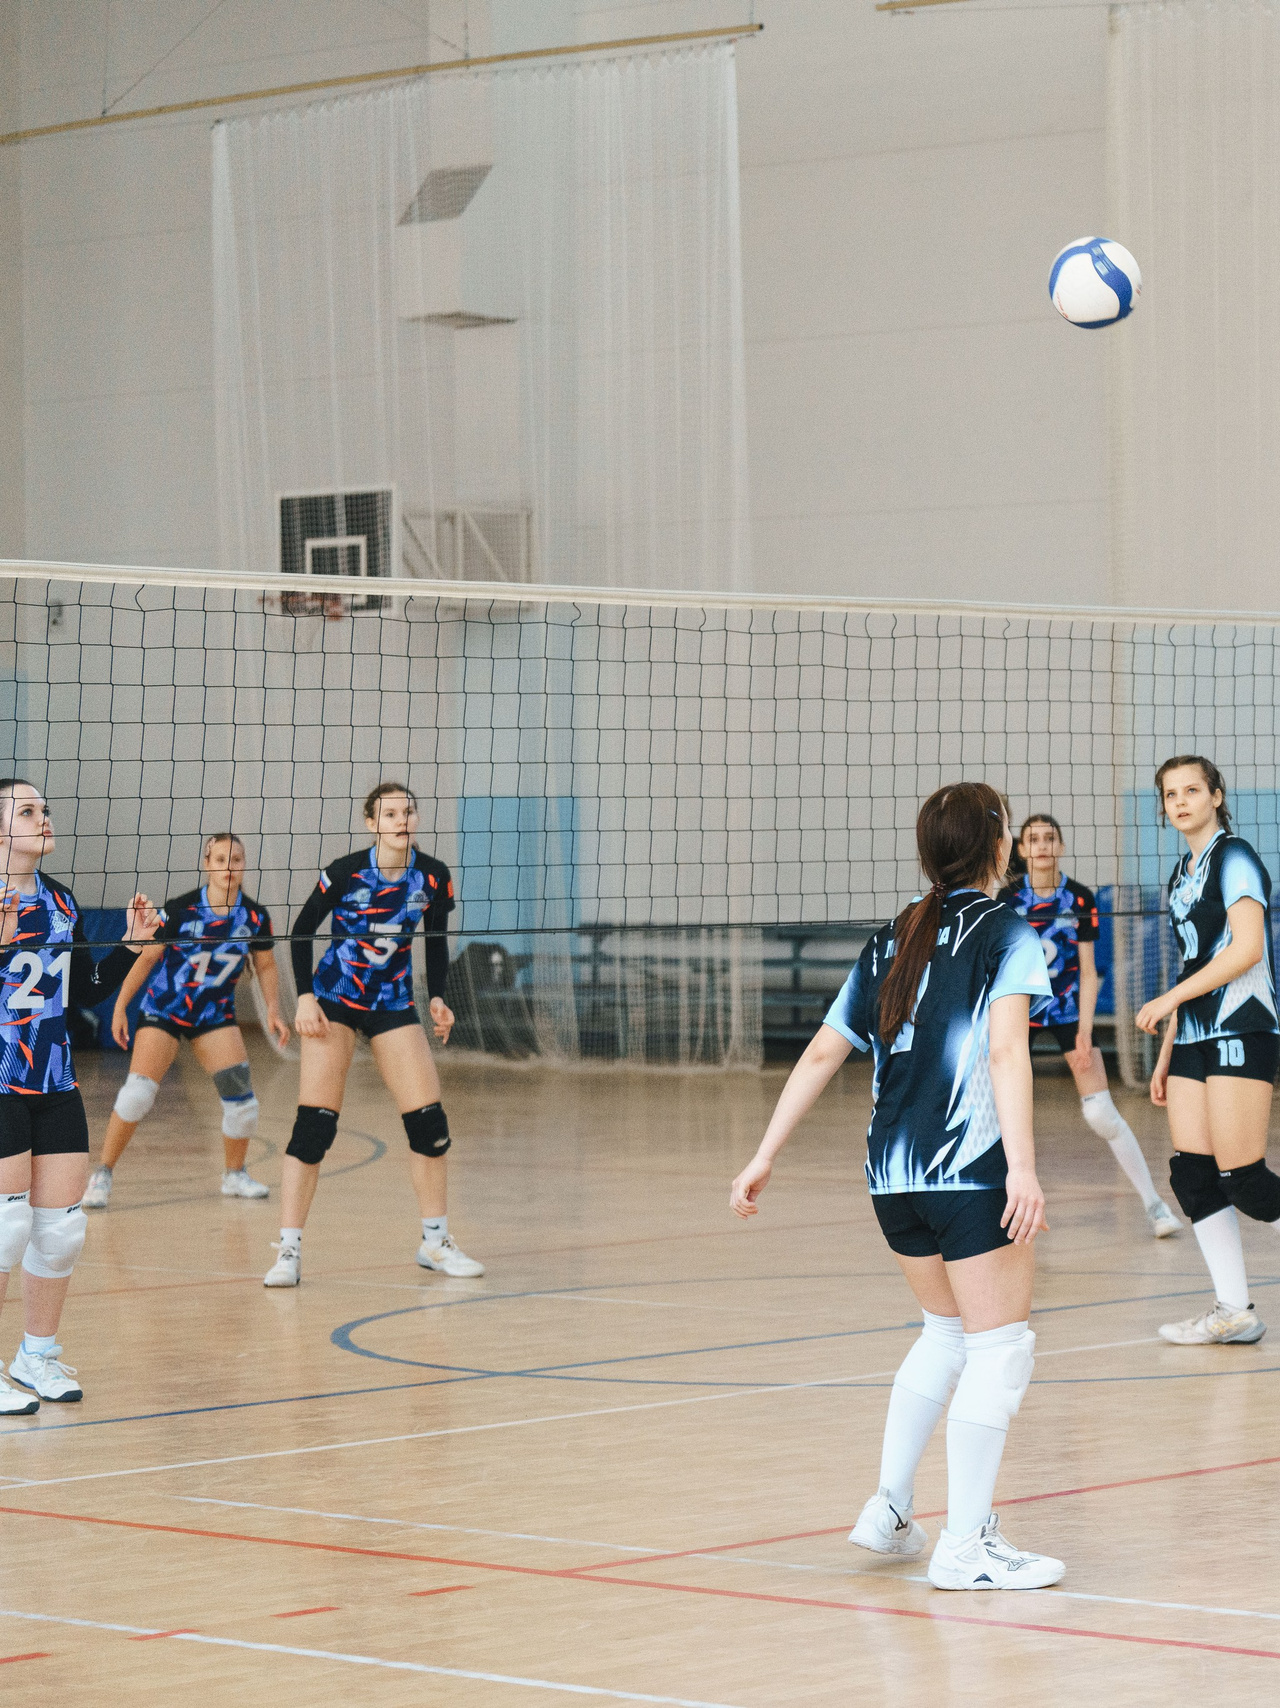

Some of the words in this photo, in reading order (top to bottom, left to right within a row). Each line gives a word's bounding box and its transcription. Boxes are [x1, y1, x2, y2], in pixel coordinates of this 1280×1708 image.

[362, 922, 403, 965] 5
[1177, 920, 1199, 962] 10
[7, 951, 72, 1009] 21
[188, 950, 243, 987] 17
[1216, 1038, 1246, 1068] 10
